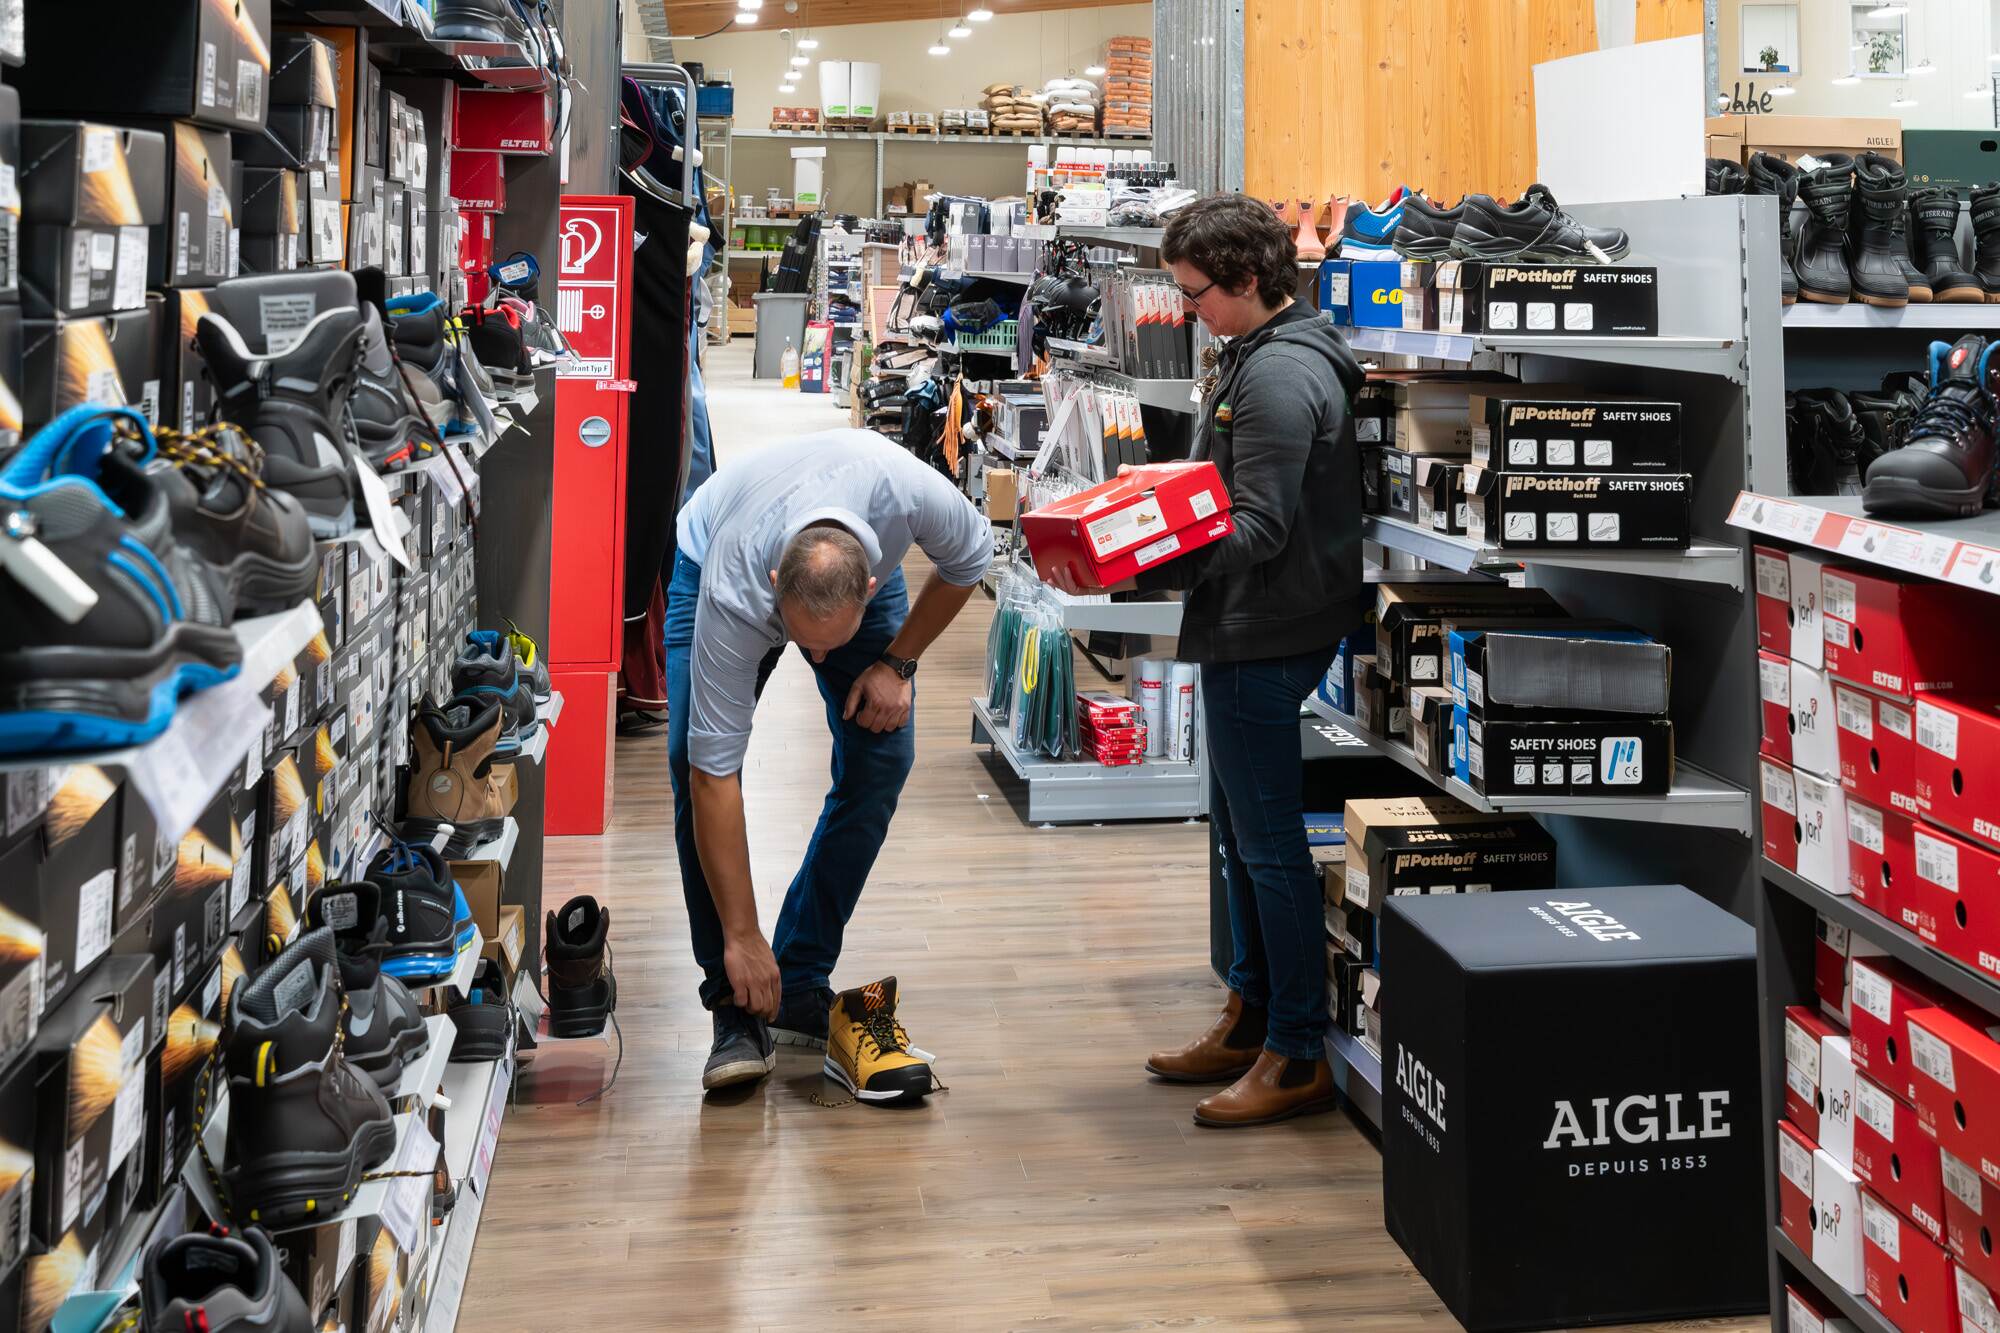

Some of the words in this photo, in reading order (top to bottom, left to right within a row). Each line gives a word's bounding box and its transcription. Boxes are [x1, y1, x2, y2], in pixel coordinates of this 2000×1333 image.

[500, 139, 540, 148] ELTEN
[458, 199, 494, 208] ELTEN
[1925, 209, 1954, 219] TERRAIN
[1505, 268, 1578, 284] Potthoff
[1583, 273, 1619, 283] SAFETY
[1620, 273, 1653, 284] SHOES
[591, 365, 602, 373] Typ
[1525, 407, 1597, 421] Potthoff
[1602, 412, 1638, 421] SAFETY
[1640, 412, 1672, 422] SHOES
[1523, 477, 1601, 492] Potthoff
[1608, 481, 1648, 491] SAFETY
[1650, 481, 1685, 492] SHOES
[1872, 670, 1902, 691] ELTEN
[1510, 738, 1554, 751] SAFETY
[1557, 738, 1597, 751] SHOES
[1973, 818, 2000, 843] ELTE
[1411, 852, 1478, 867] Potthoff
[1483, 854, 1517, 863] SAFETY
[1519, 852, 1549, 862] SHOES
[1528, 906, 1559, 926] DEPUIS
[1557, 924, 1578, 937] 1853
[1546, 901, 1642, 942] AIGLE
[1902, 907, 1919, 926] ELT
[1396, 1042, 1446, 1132] AIGLE
[1402, 1104, 1425, 1137] DEPUIS
[1426, 1127, 1440, 1154] 1853
[1543, 1090, 1731, 1150] AIGLE
[1569, 1158, 1650, 1177] DEPUIS
[1660, 1154, 1707, 1171] 1853
[1912, 1202, 1941, 1237] ELTEN
